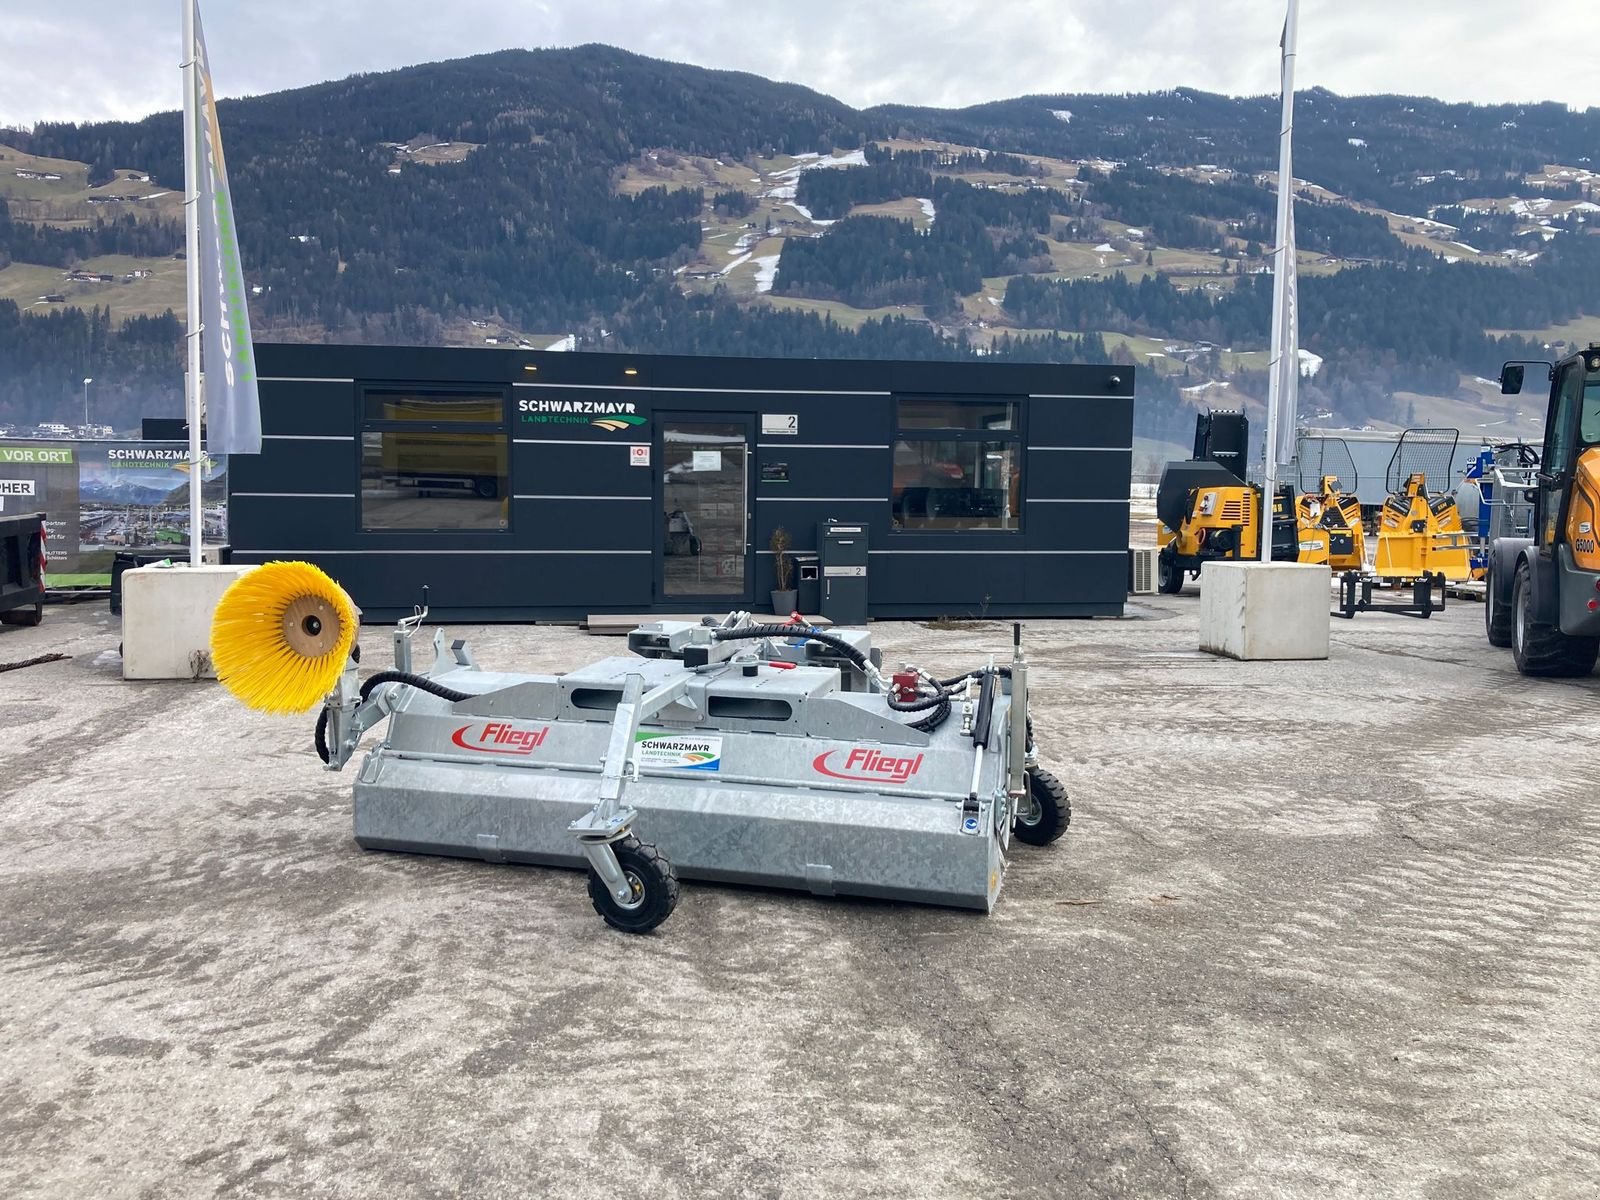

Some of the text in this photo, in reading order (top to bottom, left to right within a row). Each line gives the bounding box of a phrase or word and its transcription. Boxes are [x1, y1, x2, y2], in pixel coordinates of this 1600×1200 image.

[518, 399, 636, 414] SCHWARZMAYR
[521, 415, 589, 424] LANDTECHNIK
[788, 416, 796, 428] 2
[3, 450, 68, 462] VOR ORT
[0, 483, 31, 494] HER
[855, 567, 862, 576] 2
[479, 723, 550, 750] Fliegl
[641, 740, 710, 752] SCHWARZMAYR
[844, 748, 925, 779] Fliegl
